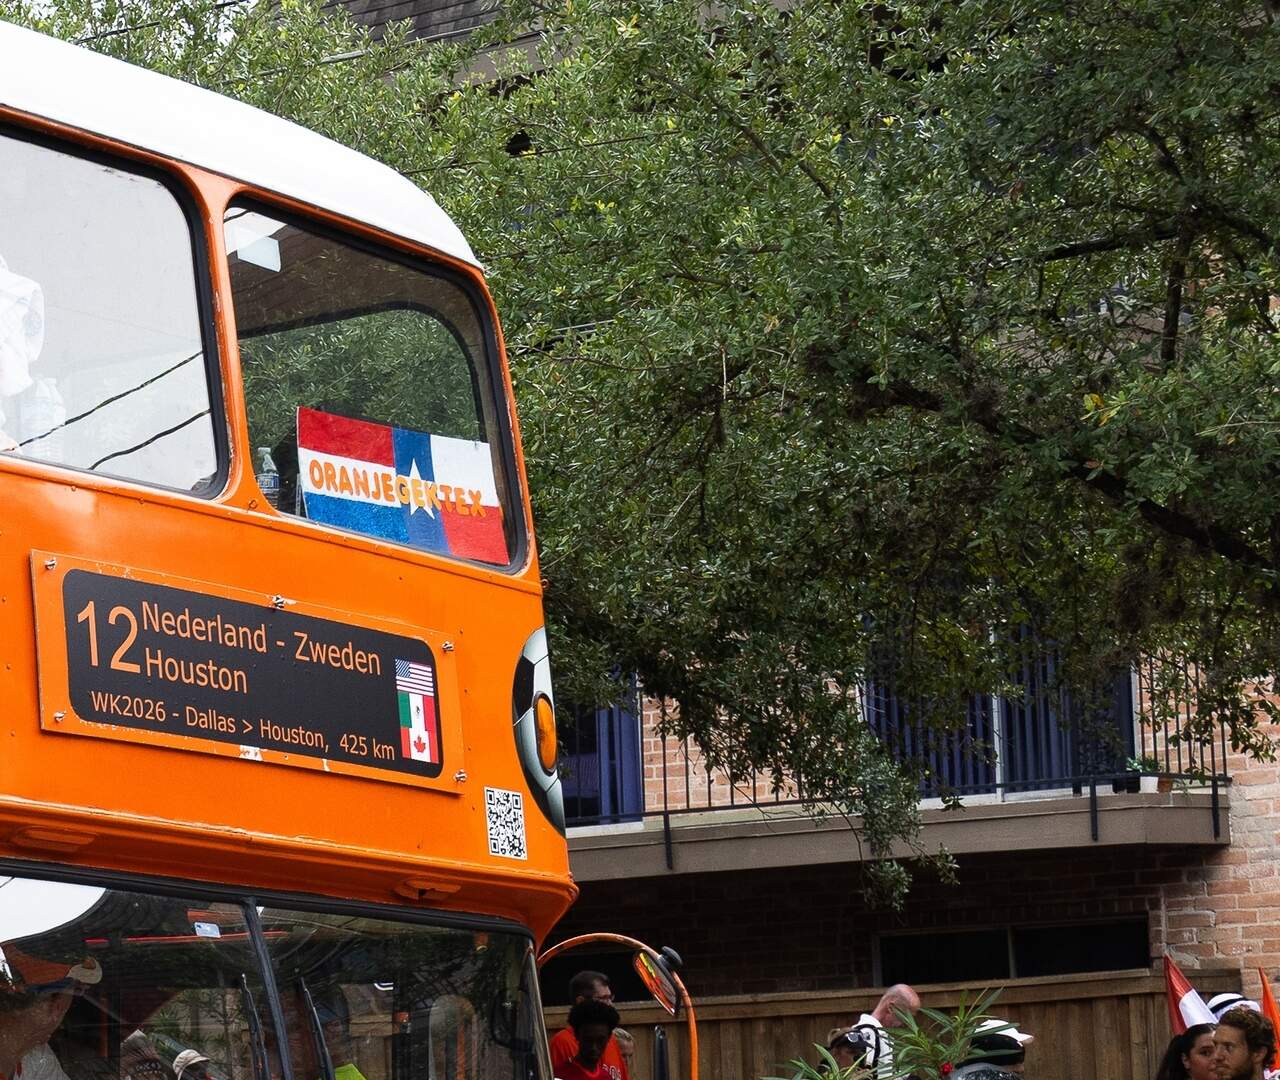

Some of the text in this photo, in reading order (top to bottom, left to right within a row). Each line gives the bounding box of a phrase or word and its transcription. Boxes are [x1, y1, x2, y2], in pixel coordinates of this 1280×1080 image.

[77, 601, 141, 674] 12
[142, 601, 267, 653] Nederland
[294, 631, 381, 675] Zweden
[145, 647, 248, 694] Houston
[91, 690, 166, 722] WK2026
[186, 706, 236, 734] Dallas
[260, 719, 329, 752] Houston,
[340, 733, 367, 756] 425
[373, 738, 395, 761] km
